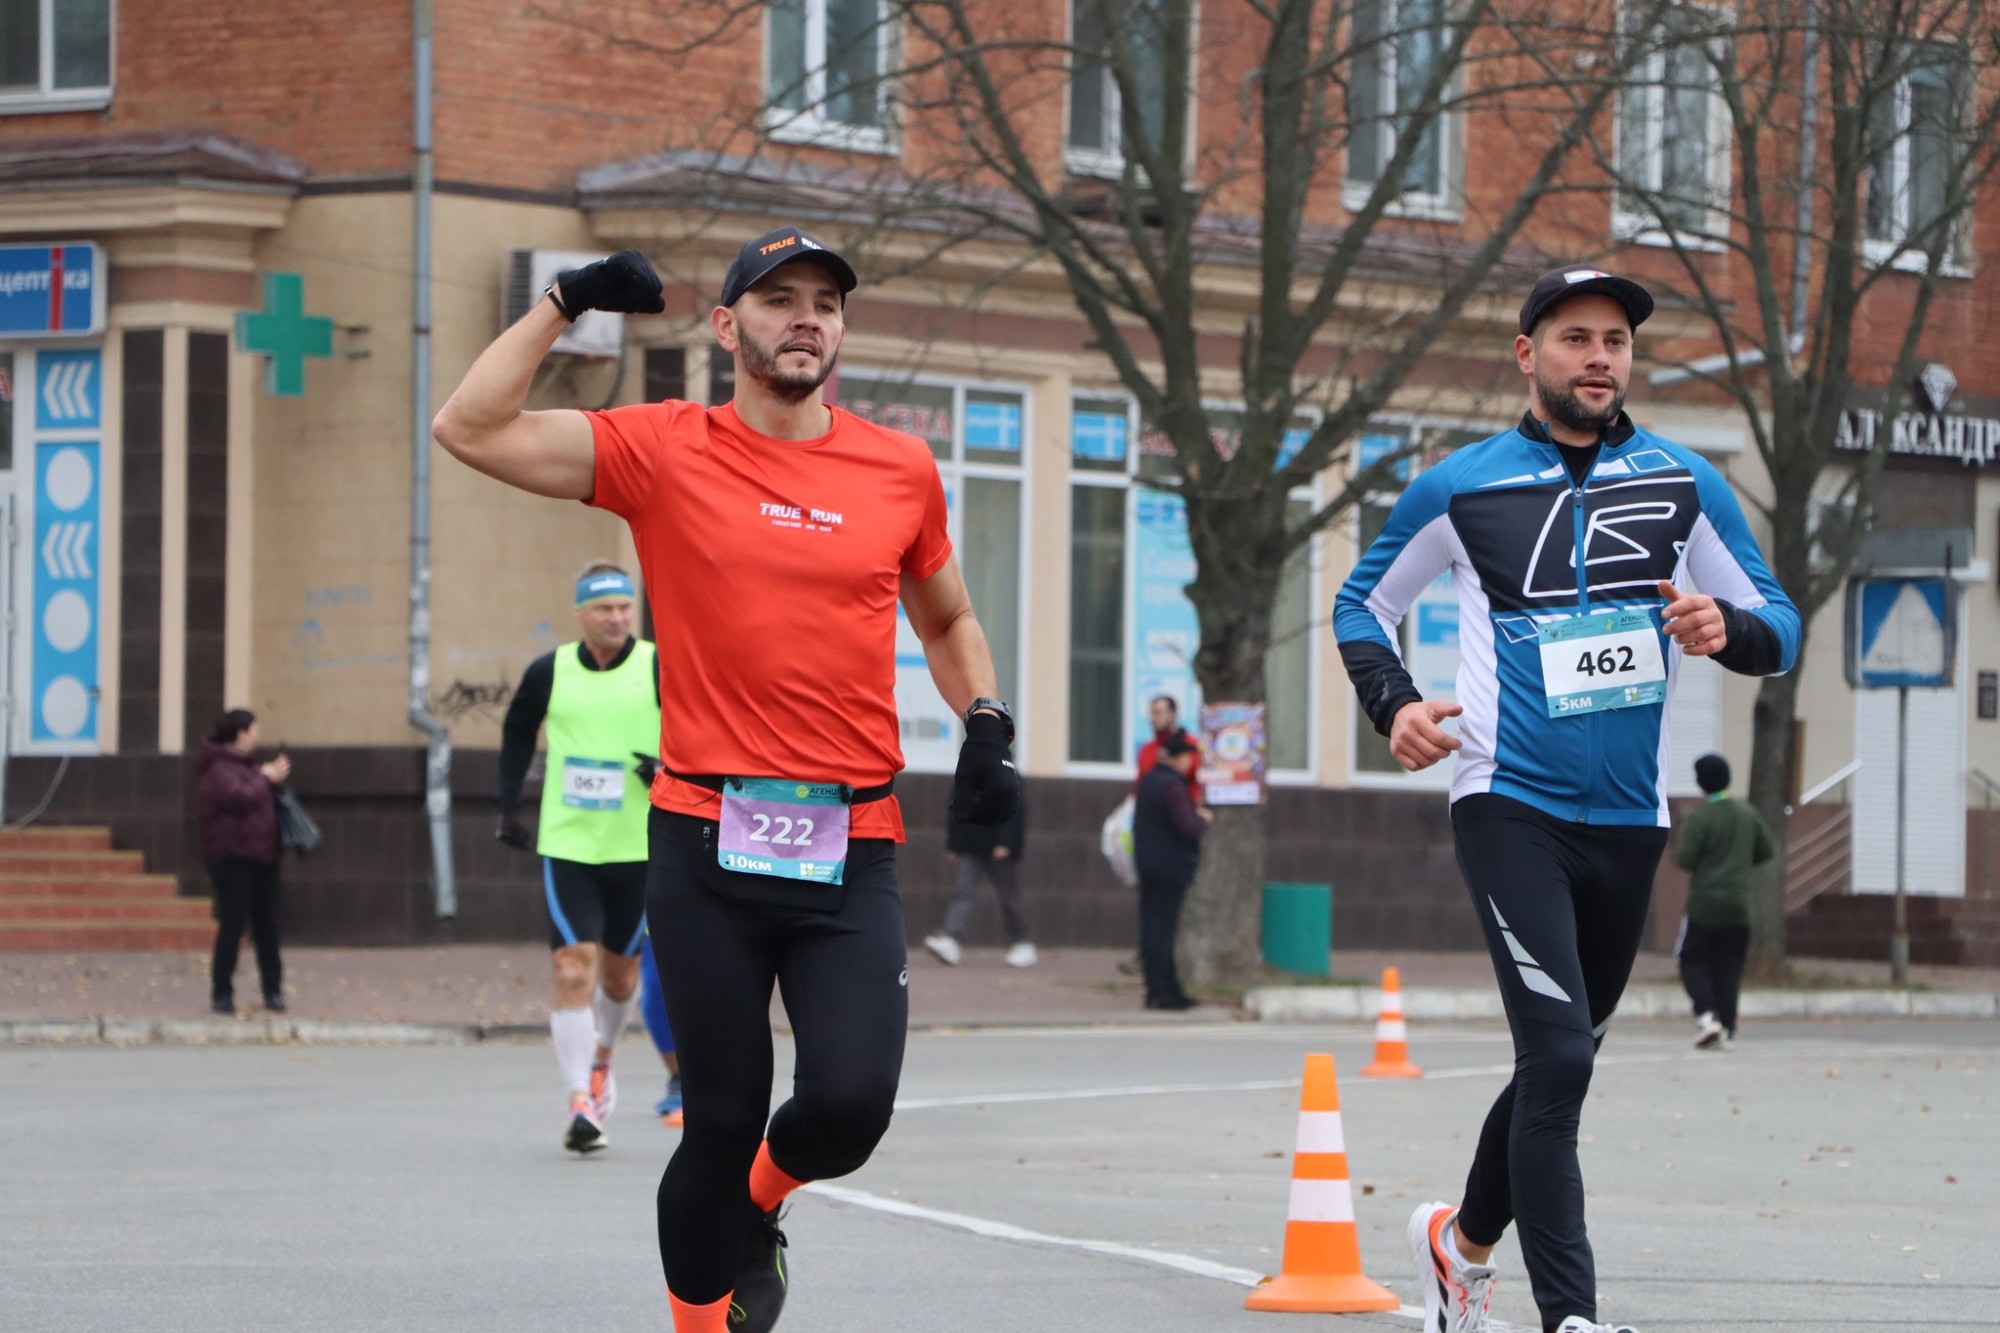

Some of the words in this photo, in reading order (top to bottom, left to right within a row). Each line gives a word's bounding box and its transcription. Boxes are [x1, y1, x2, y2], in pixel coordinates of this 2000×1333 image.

[759, 236, 796, 256] TRUE
[759, 502, 801, 519] TRUE
[810, 508, 843, 524] RUN
[1576, 645, 1636, 677] 462
[749, 813, 815, 846] 222
